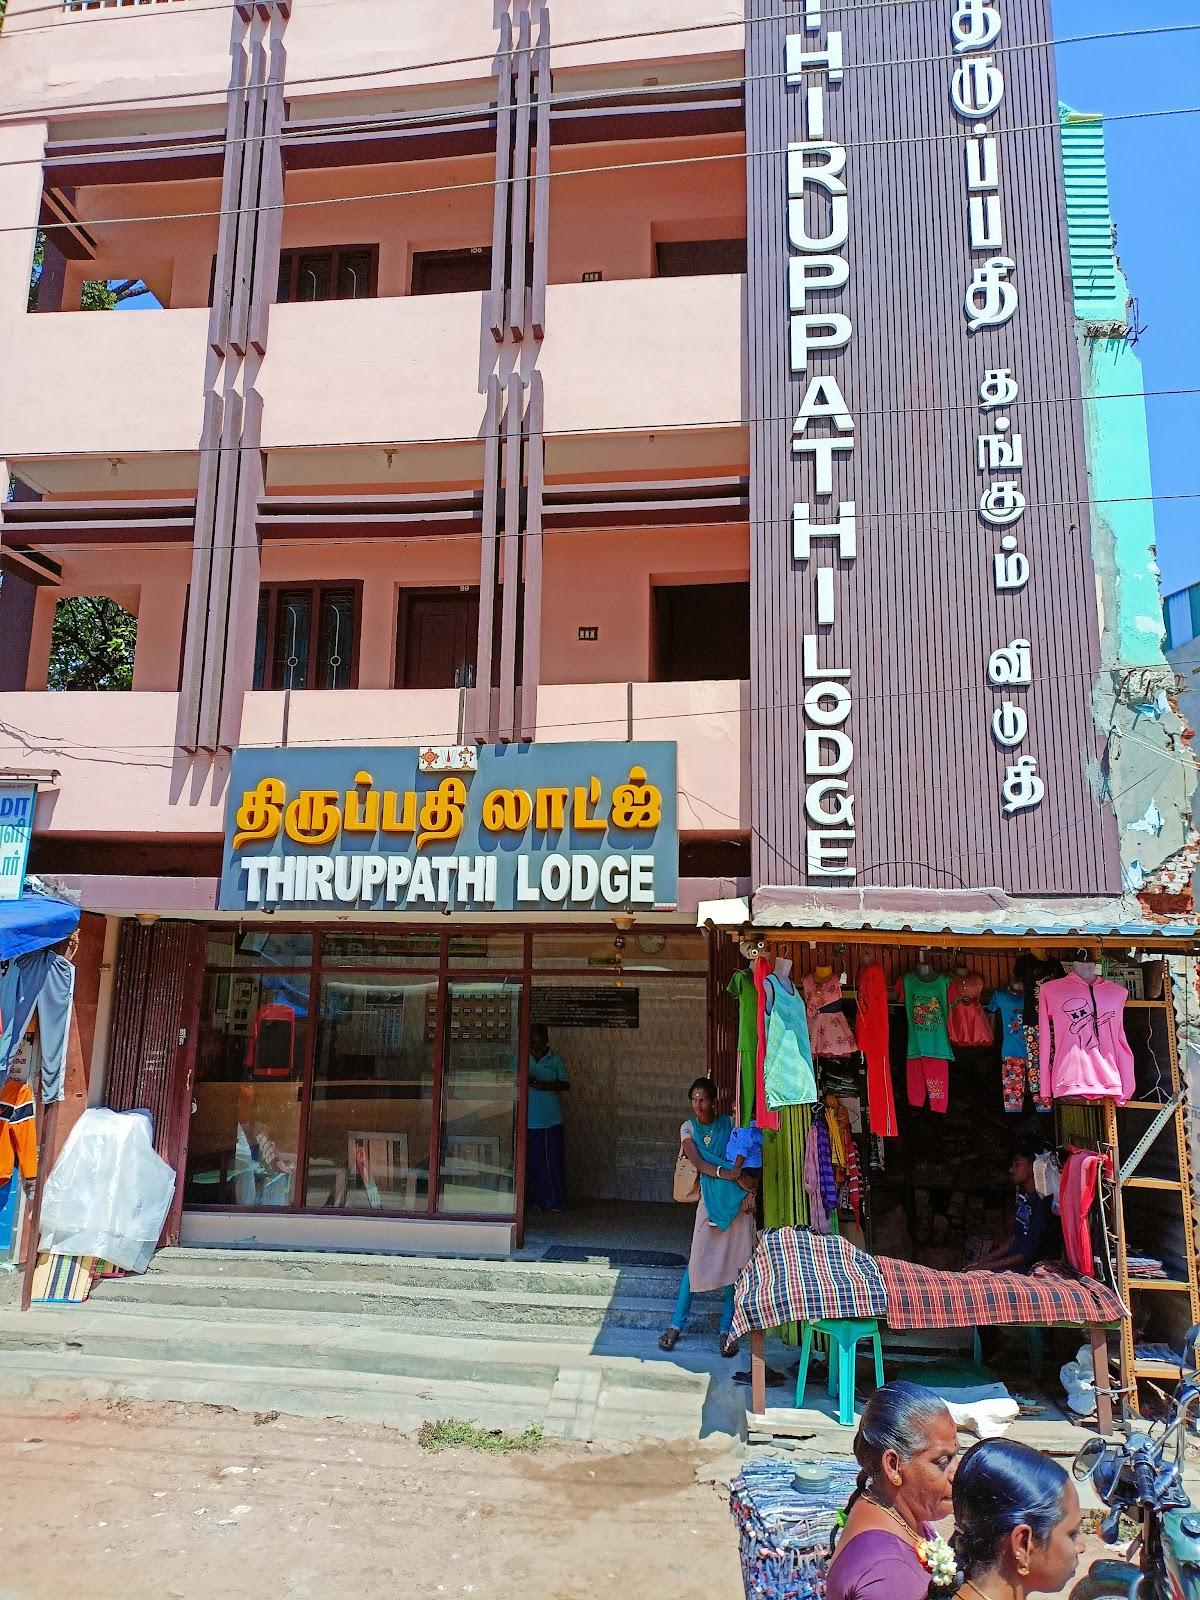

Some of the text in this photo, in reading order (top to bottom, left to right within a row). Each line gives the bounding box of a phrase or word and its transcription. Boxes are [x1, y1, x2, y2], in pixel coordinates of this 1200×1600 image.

[976, 366, 1031, 591] தங்கும்
[232, 764, 663, 850] திருப்பதி லாட்ஜ்
[803, 634, 857, 878] LODGE
[987, 636, 1046, 814] விடுதி
[240, 853, 656, 904] THIRUPPATHI LODGE
